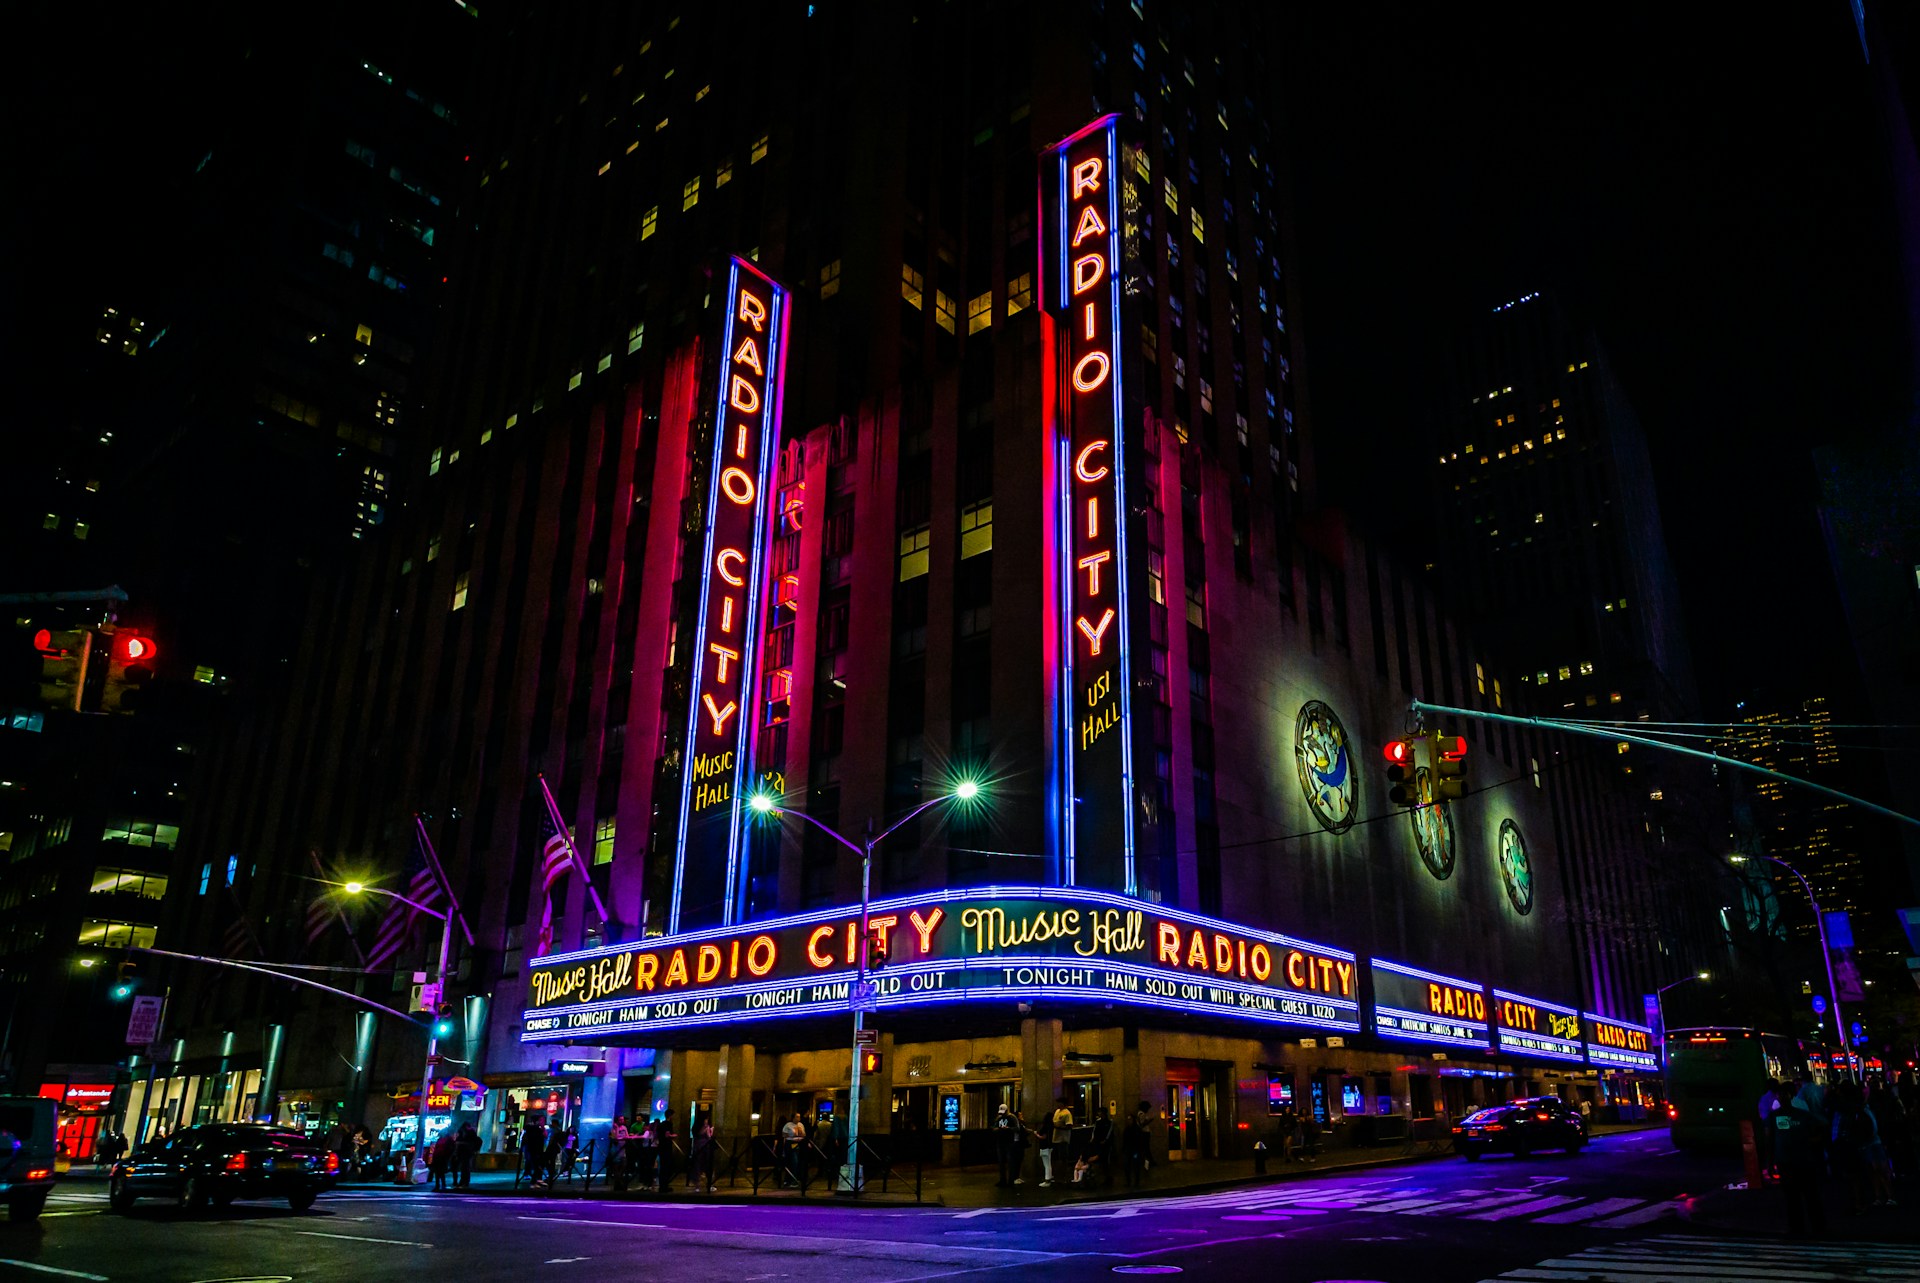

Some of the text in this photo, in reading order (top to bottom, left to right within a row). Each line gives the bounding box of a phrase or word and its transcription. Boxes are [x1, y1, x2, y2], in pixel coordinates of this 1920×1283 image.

[1072, 157, 1114, 655] RADIO CITY
[703, 289, 767, 736] RADIO CITY
[1083, 702, 1120, 751] HALL
[693, 751, 733, 782] MUSIC
[696, 782, 730, 812] HALL
[961, 907, 1145, 957] Music Hall
[532, 907, 944, 1007] Music Hall RADIO CITY
[1159, 921, 1351, 995] RADIO CITY
[745, 988, 803, 1009] TONIGHT
[812, 982, 848, 1001] HAIM
[862, 977, 900, 995] OLD
[911, 972, 946, 990] OUT
[1003, 968, 1335, 1020] TONIGHT HAIM SOLD OUT WITH SPECIAL GUEST LIZZO
[1429, 983, 1485, 1020] RADIO
[527, 997, 720, 1030] CHASE TONIGHT HAIM SOLD OUT
[1401, 1019, 1427, 1032] ANTHONY
[1430, 1023, 1451, 1036] SANTOS
[1504, 1001, 1536, 1030] CITY
[1596, 1022, 1647, 1051] RADIO CITY
[562, 1063, 588, 1073] Subway
